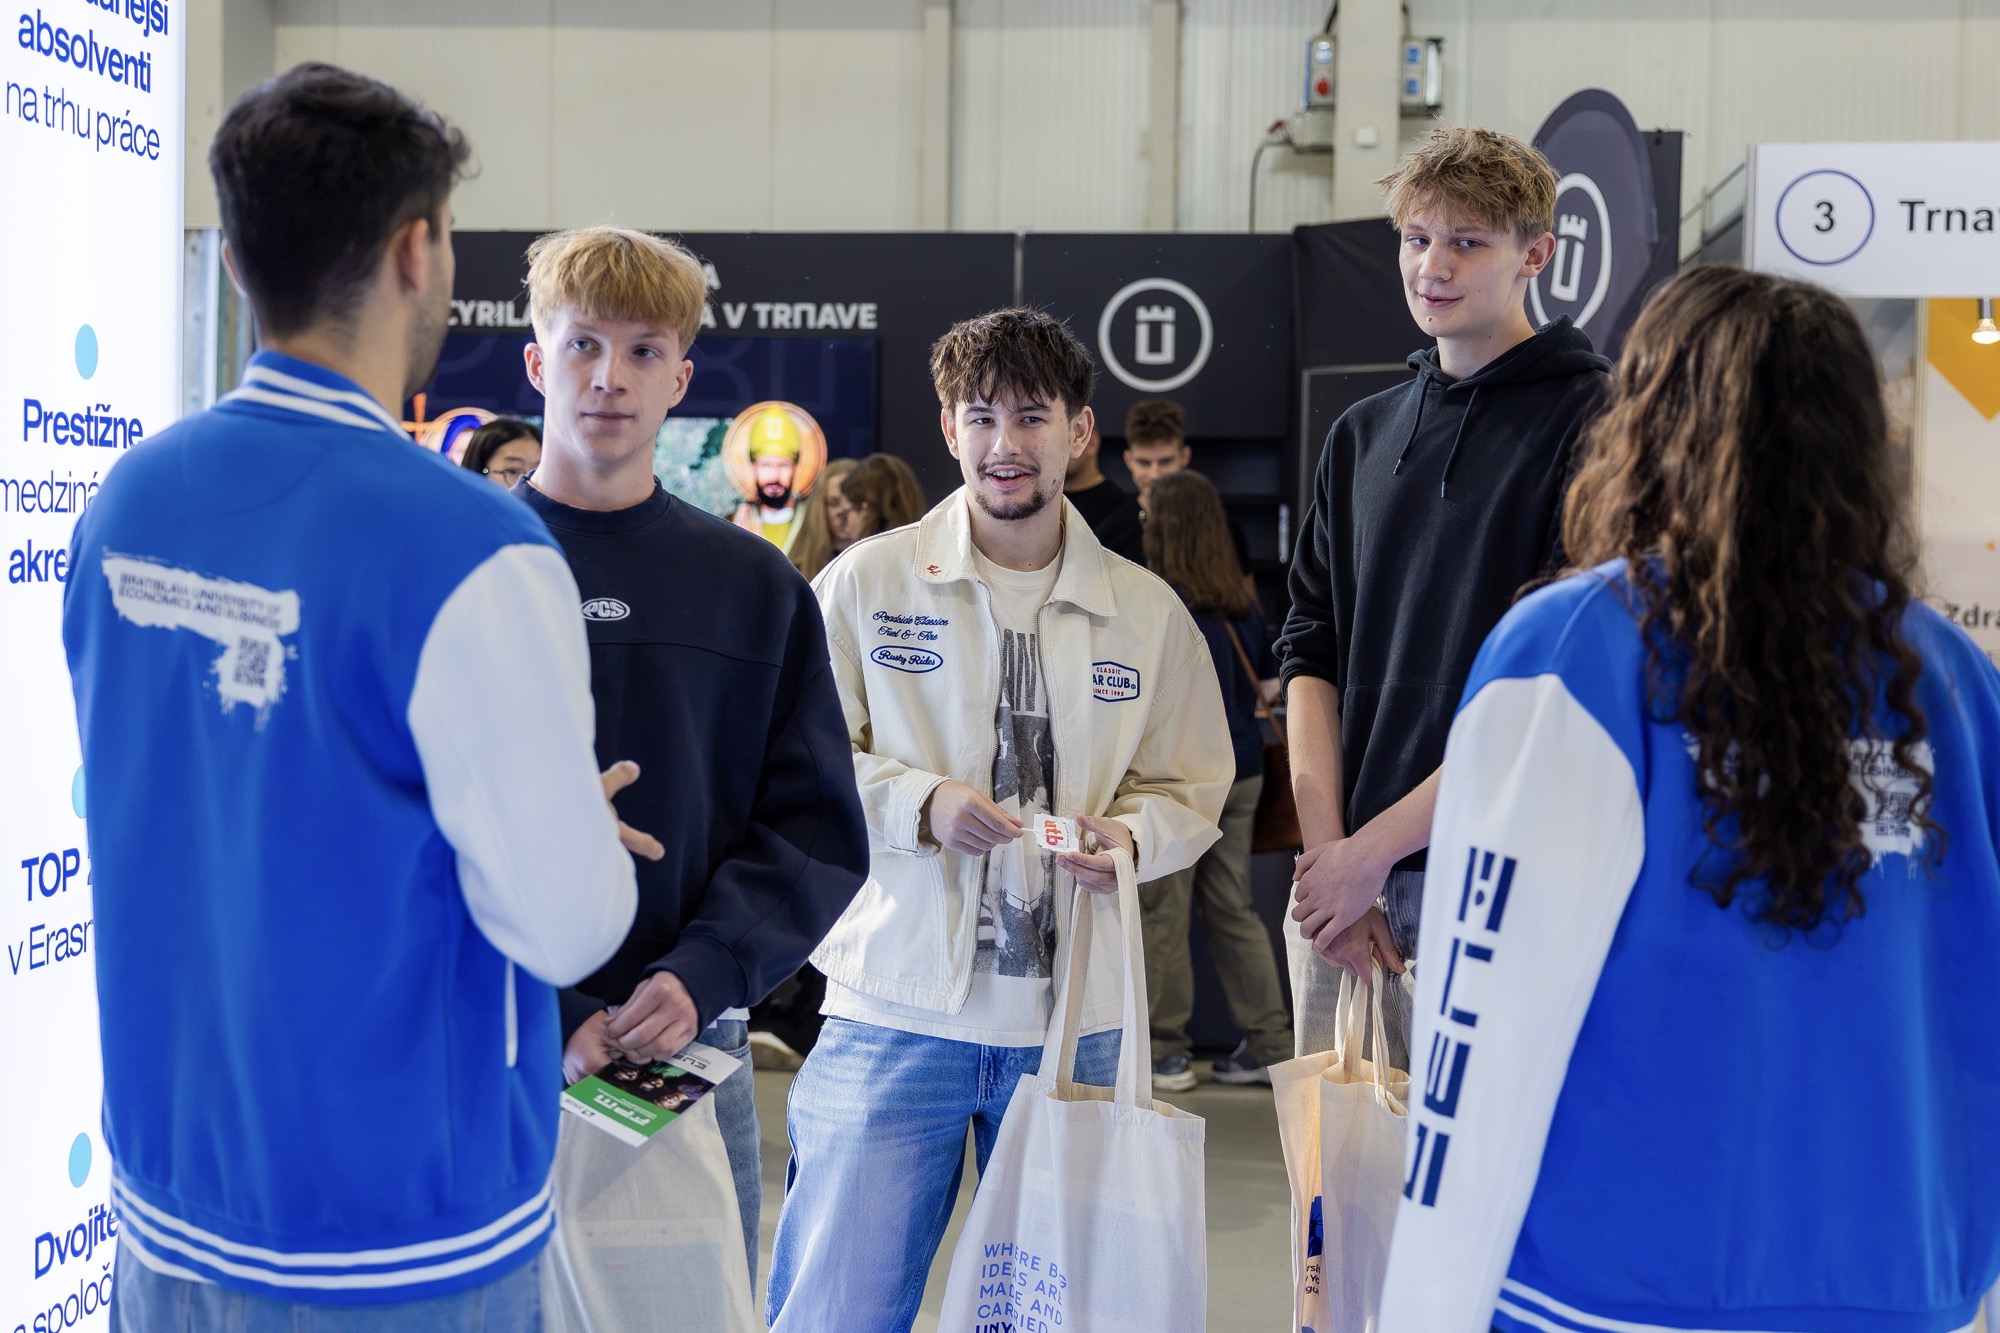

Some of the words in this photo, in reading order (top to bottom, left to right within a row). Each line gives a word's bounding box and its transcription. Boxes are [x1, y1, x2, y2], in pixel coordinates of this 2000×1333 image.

[18, 8, 151, 94] absolventi
[6, 81, 39, 124] na
[43, 85, 91, 139] trhu
[96, 109, 160, 161] práce
[1814, 201, 1835, 232] 3
[1899, 200, 2000, 232] Trna
[722, 303, 747, 329] V
[23, 398, 143, 449] Prestížne
[873, 611, 914, 624] Roadside
[878, 626, 902, 638] Fuel
[901, 629, 916, 640] &
[878, 650, 907, 665] Rusty
[908, 655, 936, 665] Rides
[21, 848, 80, 901] TOP
[8, 941, 24, 976] v
[984, 1242, 1042, 1272] WHERE
[982, 1261, 1028, 1287] IDEAS
[977, 1302, 1048, 1333] CARRIED
[980, 1282, 1023, 1307] MADE
[1030, 1299, 1063, 1325] AND
